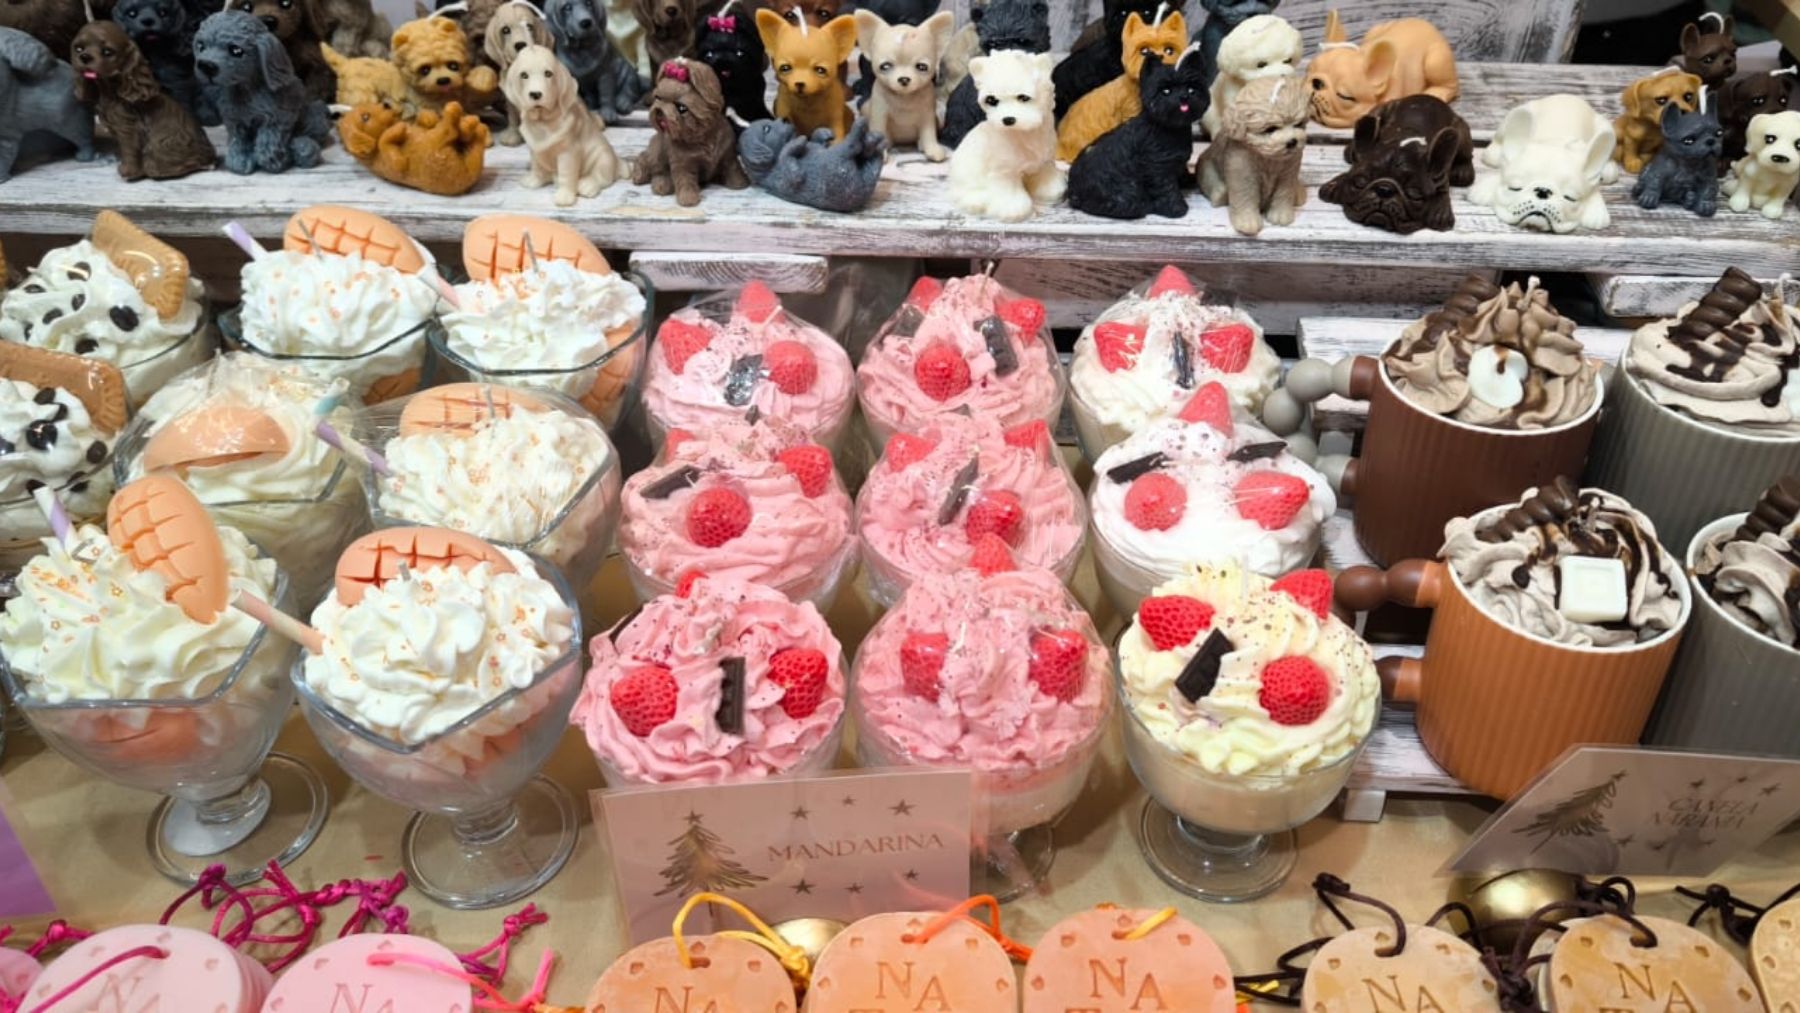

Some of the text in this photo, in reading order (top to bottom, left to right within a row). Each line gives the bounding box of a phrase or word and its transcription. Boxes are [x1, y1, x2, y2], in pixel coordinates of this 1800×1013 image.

[767, 833, 944, 862] MANDARINA
[875, 961, 952, 1012] NA
[1089, 957, 1168, 1010] NA
[1614, 962, 1698, 1013] NA
